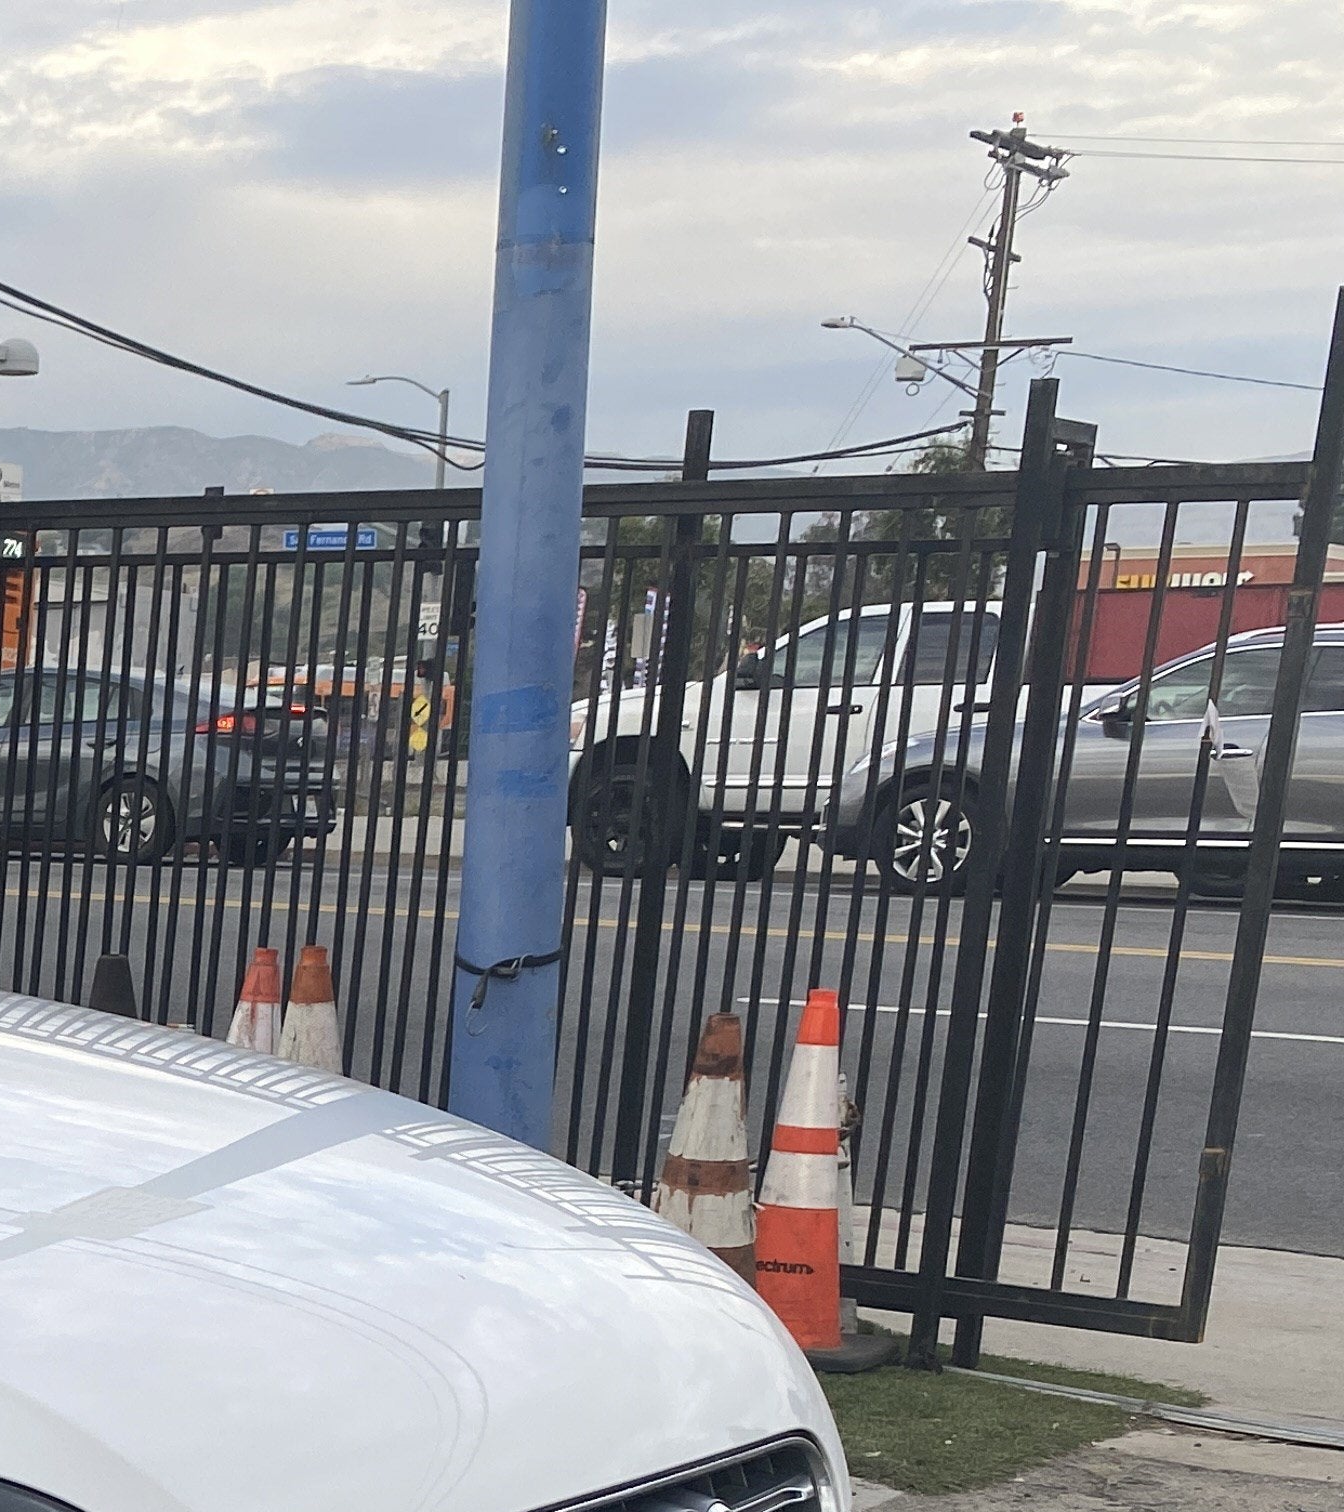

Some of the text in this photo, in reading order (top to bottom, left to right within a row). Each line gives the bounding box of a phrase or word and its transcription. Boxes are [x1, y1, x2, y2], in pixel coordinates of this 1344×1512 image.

[358, 533, 372, 545] Rd
[418, 622, 439, 636] 40
[756, 1259, 810, 1274] ectrum
